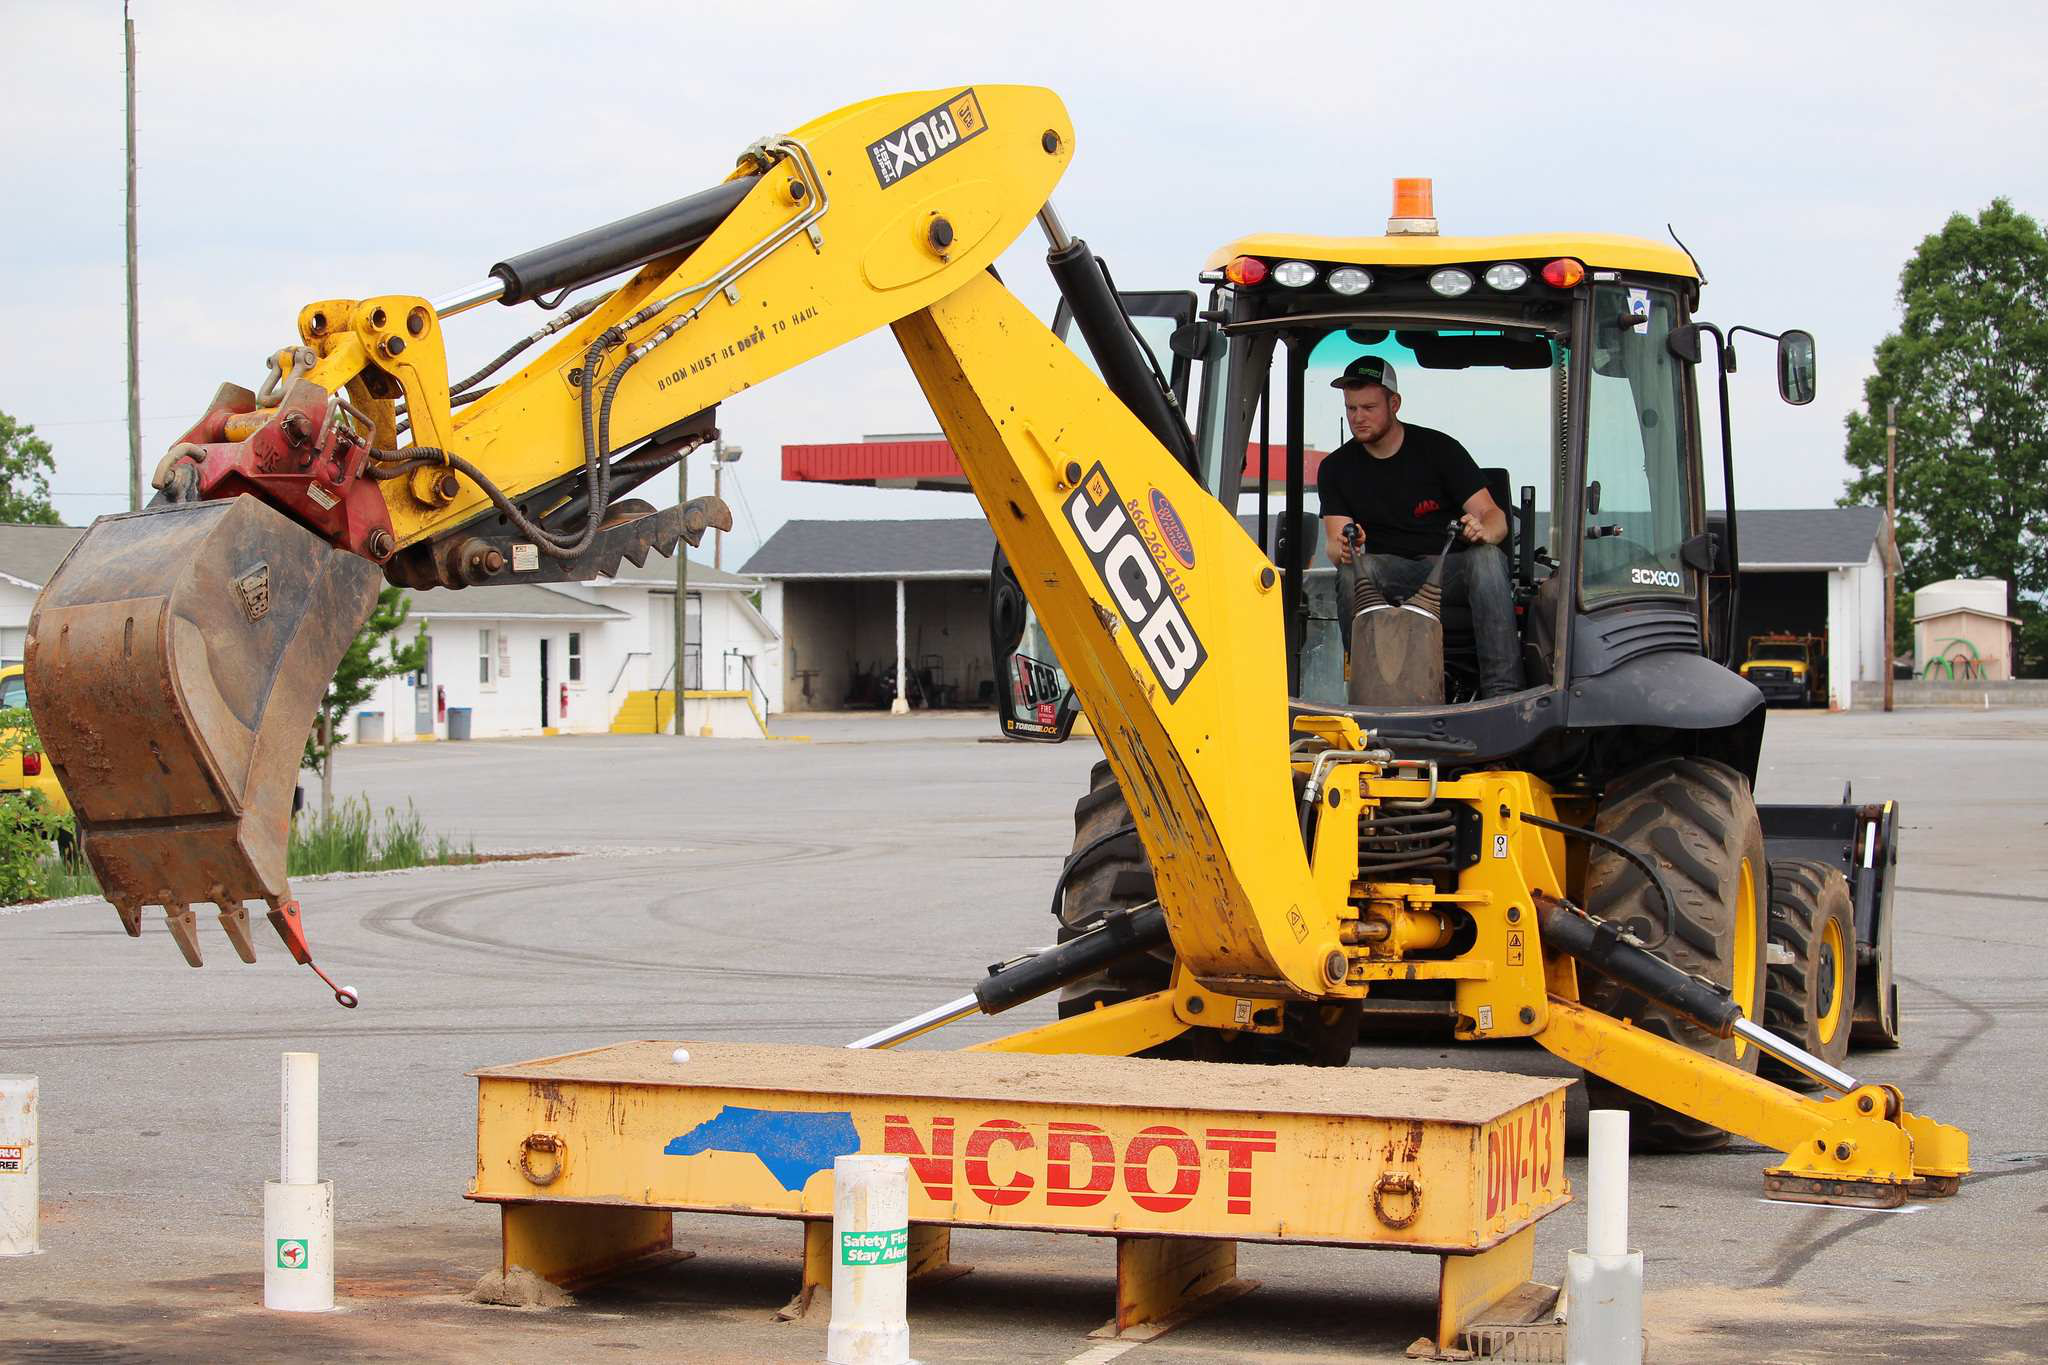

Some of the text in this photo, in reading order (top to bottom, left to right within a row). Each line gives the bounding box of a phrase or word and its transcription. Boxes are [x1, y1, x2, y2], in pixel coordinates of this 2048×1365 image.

[884, 109, 957, 178] 3CX
[958, 103, 975, 131] JCB
[872, 146, 891, 183] SUPER
[657, 367, 688, 391] BOOM
[690, 352, 718, 375] MUST
[737, 329, 767, 353] DOWN
[772, 319, 786, 335] TO
[791, 305, 819, 325] HAUL
[1127, 499, 1191, 603] 866-262-4181
[1157, 509, 1186, 554] Wrench
[1158, 496, 1192, 554] Company
[1071, 492, 1198, 690] JCB
[1024, 661, 1059, 704] JCB
[884, 1114, 1277, 1215] NCDOT
[1486, 1102, 1552, 1221] DIV-13
[843, 1234, 888, 1249] Safety
[847, 1249, 880, 1264] Stay
